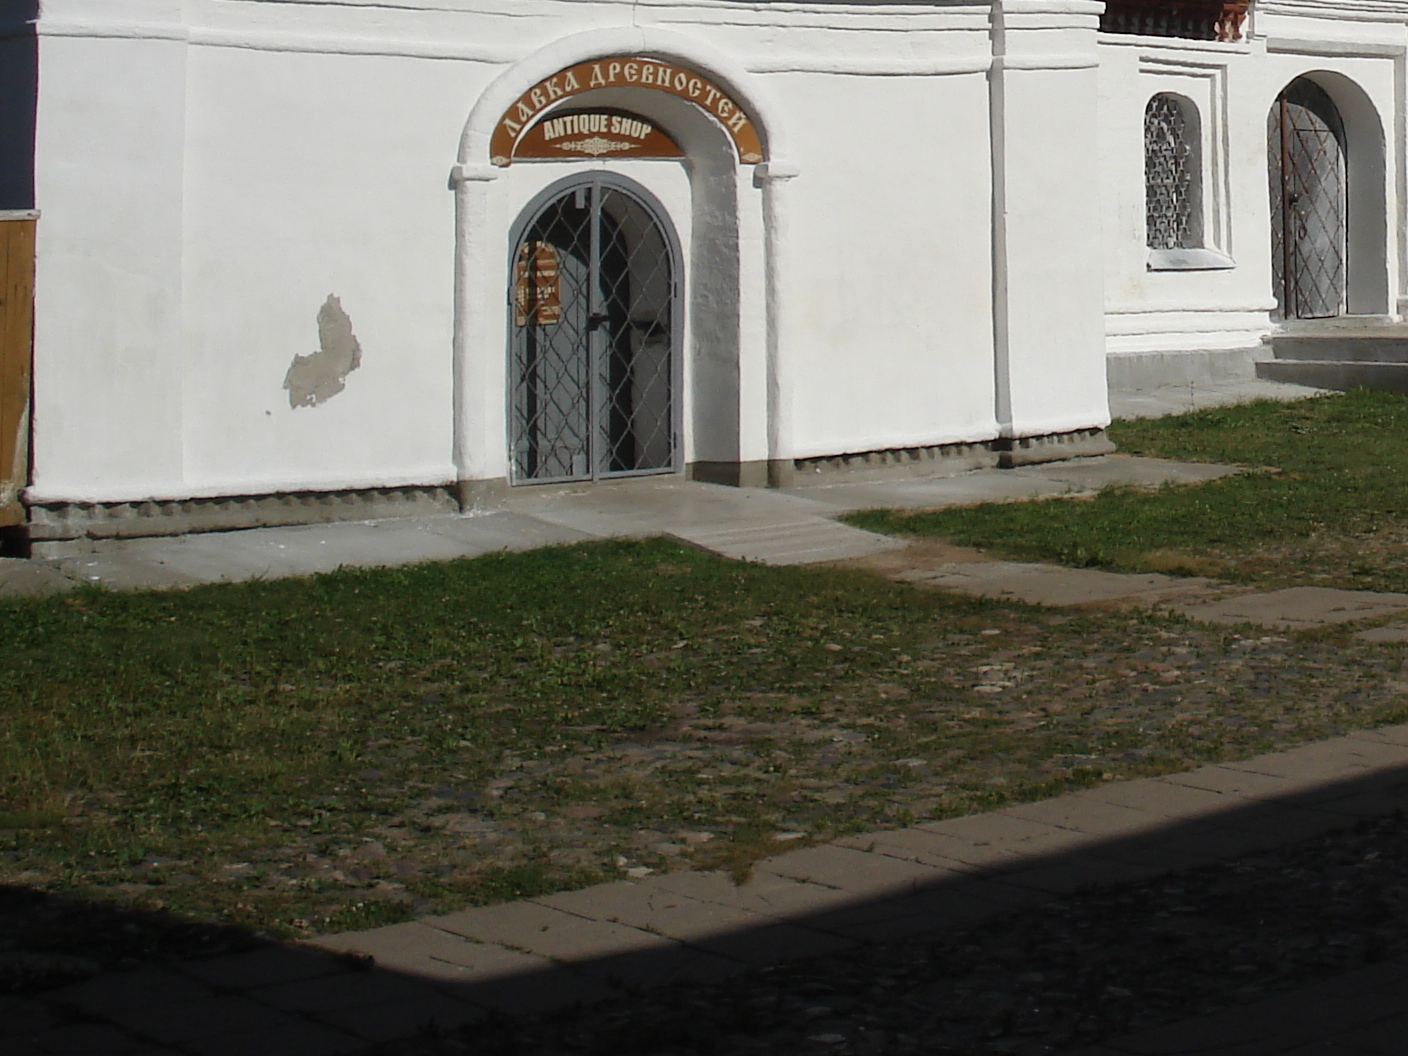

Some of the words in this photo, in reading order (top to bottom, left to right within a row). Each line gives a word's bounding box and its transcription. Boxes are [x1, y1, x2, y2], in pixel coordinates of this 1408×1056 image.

[503, 71, 580, 138] ЛАВКА
[589, 62, 747, 134] ДРЕВНОСТЕЙ
[543, 114, 608, 141] ANTIQUE
[610, 116, 652, 140] SHOP
